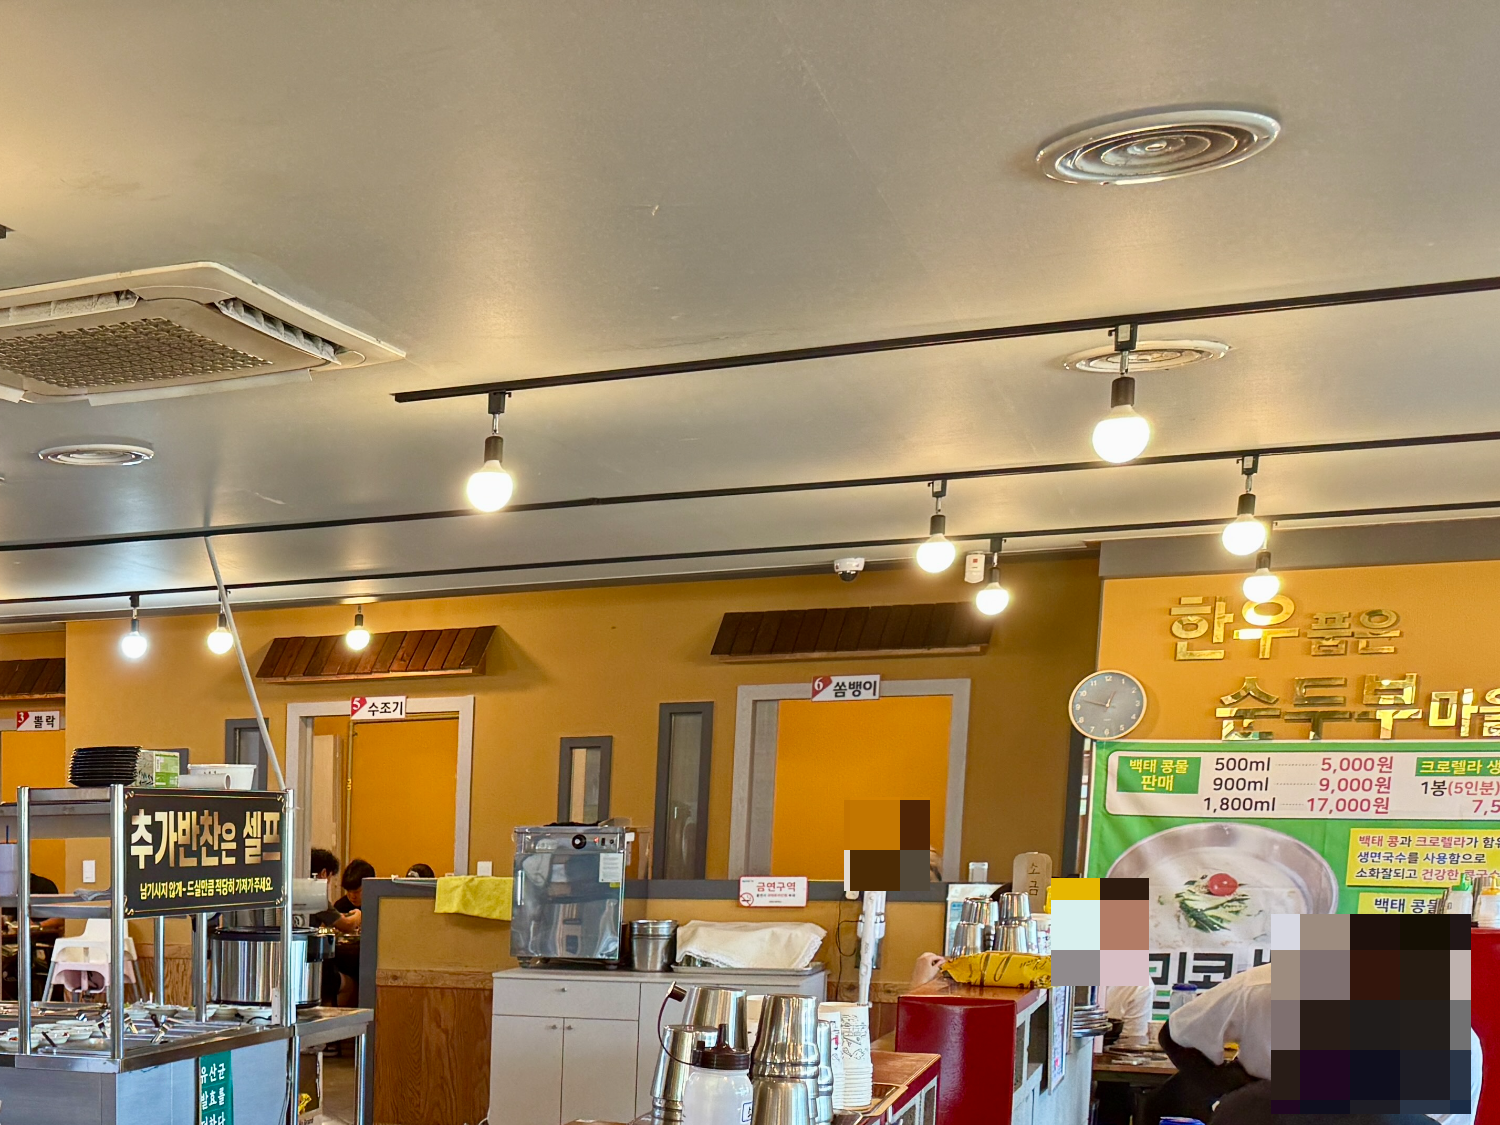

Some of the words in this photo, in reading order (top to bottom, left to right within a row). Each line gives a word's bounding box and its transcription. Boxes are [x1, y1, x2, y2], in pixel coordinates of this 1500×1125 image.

[1171, 595, 1299, 661] 한우
[814, 677, 824, 691] 6
[832, 680, 877, 698] 쏨뱅이
[352, 697, 361, 710] 5
[367, 701, 403, 716] 수조기
[17, 711, 25, 723] 3
[1129, 759, 1157, 774] 백태
[1160, 759, 1189, 774] 콩물
[1215, 757, 1271, 772] 500ml
[1321, 756, 1394, 774] 5,000원
[1140, 775, 1175, 792] 판매
[1213, 777, 1269, 792] 900ml
[1319, 776, 1392, 795] 9,000원
[1203, 797, 1276, 813] 1,800ml
[1307, 797, 1390, 815] 17,000원
[130, 808, 237, 870] 추가반찬은
[243, 810, 281, 865] 셀프
[1359, 836, 1384, 847] 백태
[1387, 836, 1412, 848] 콩과
[1483, 837, 1500, 848] 함
[1357, 851, 1419, 864] 생면국수를
[1423, 852, 1487, 865] 사용함으로
[1355, 868, 1418, 879] 소화잘되고
[1421, 869, 1459, 881] 건강한
[187, 878, 215, 897] 드실만큼
[215, 877, 235, 896] 적당히
[756, 881, 796, 892] 금연구역
[1374, 898, 1405, 913] 백태
[200, 1062, 226, 1084] 유산균
[200, 1087, 226, 1110] 발효를
